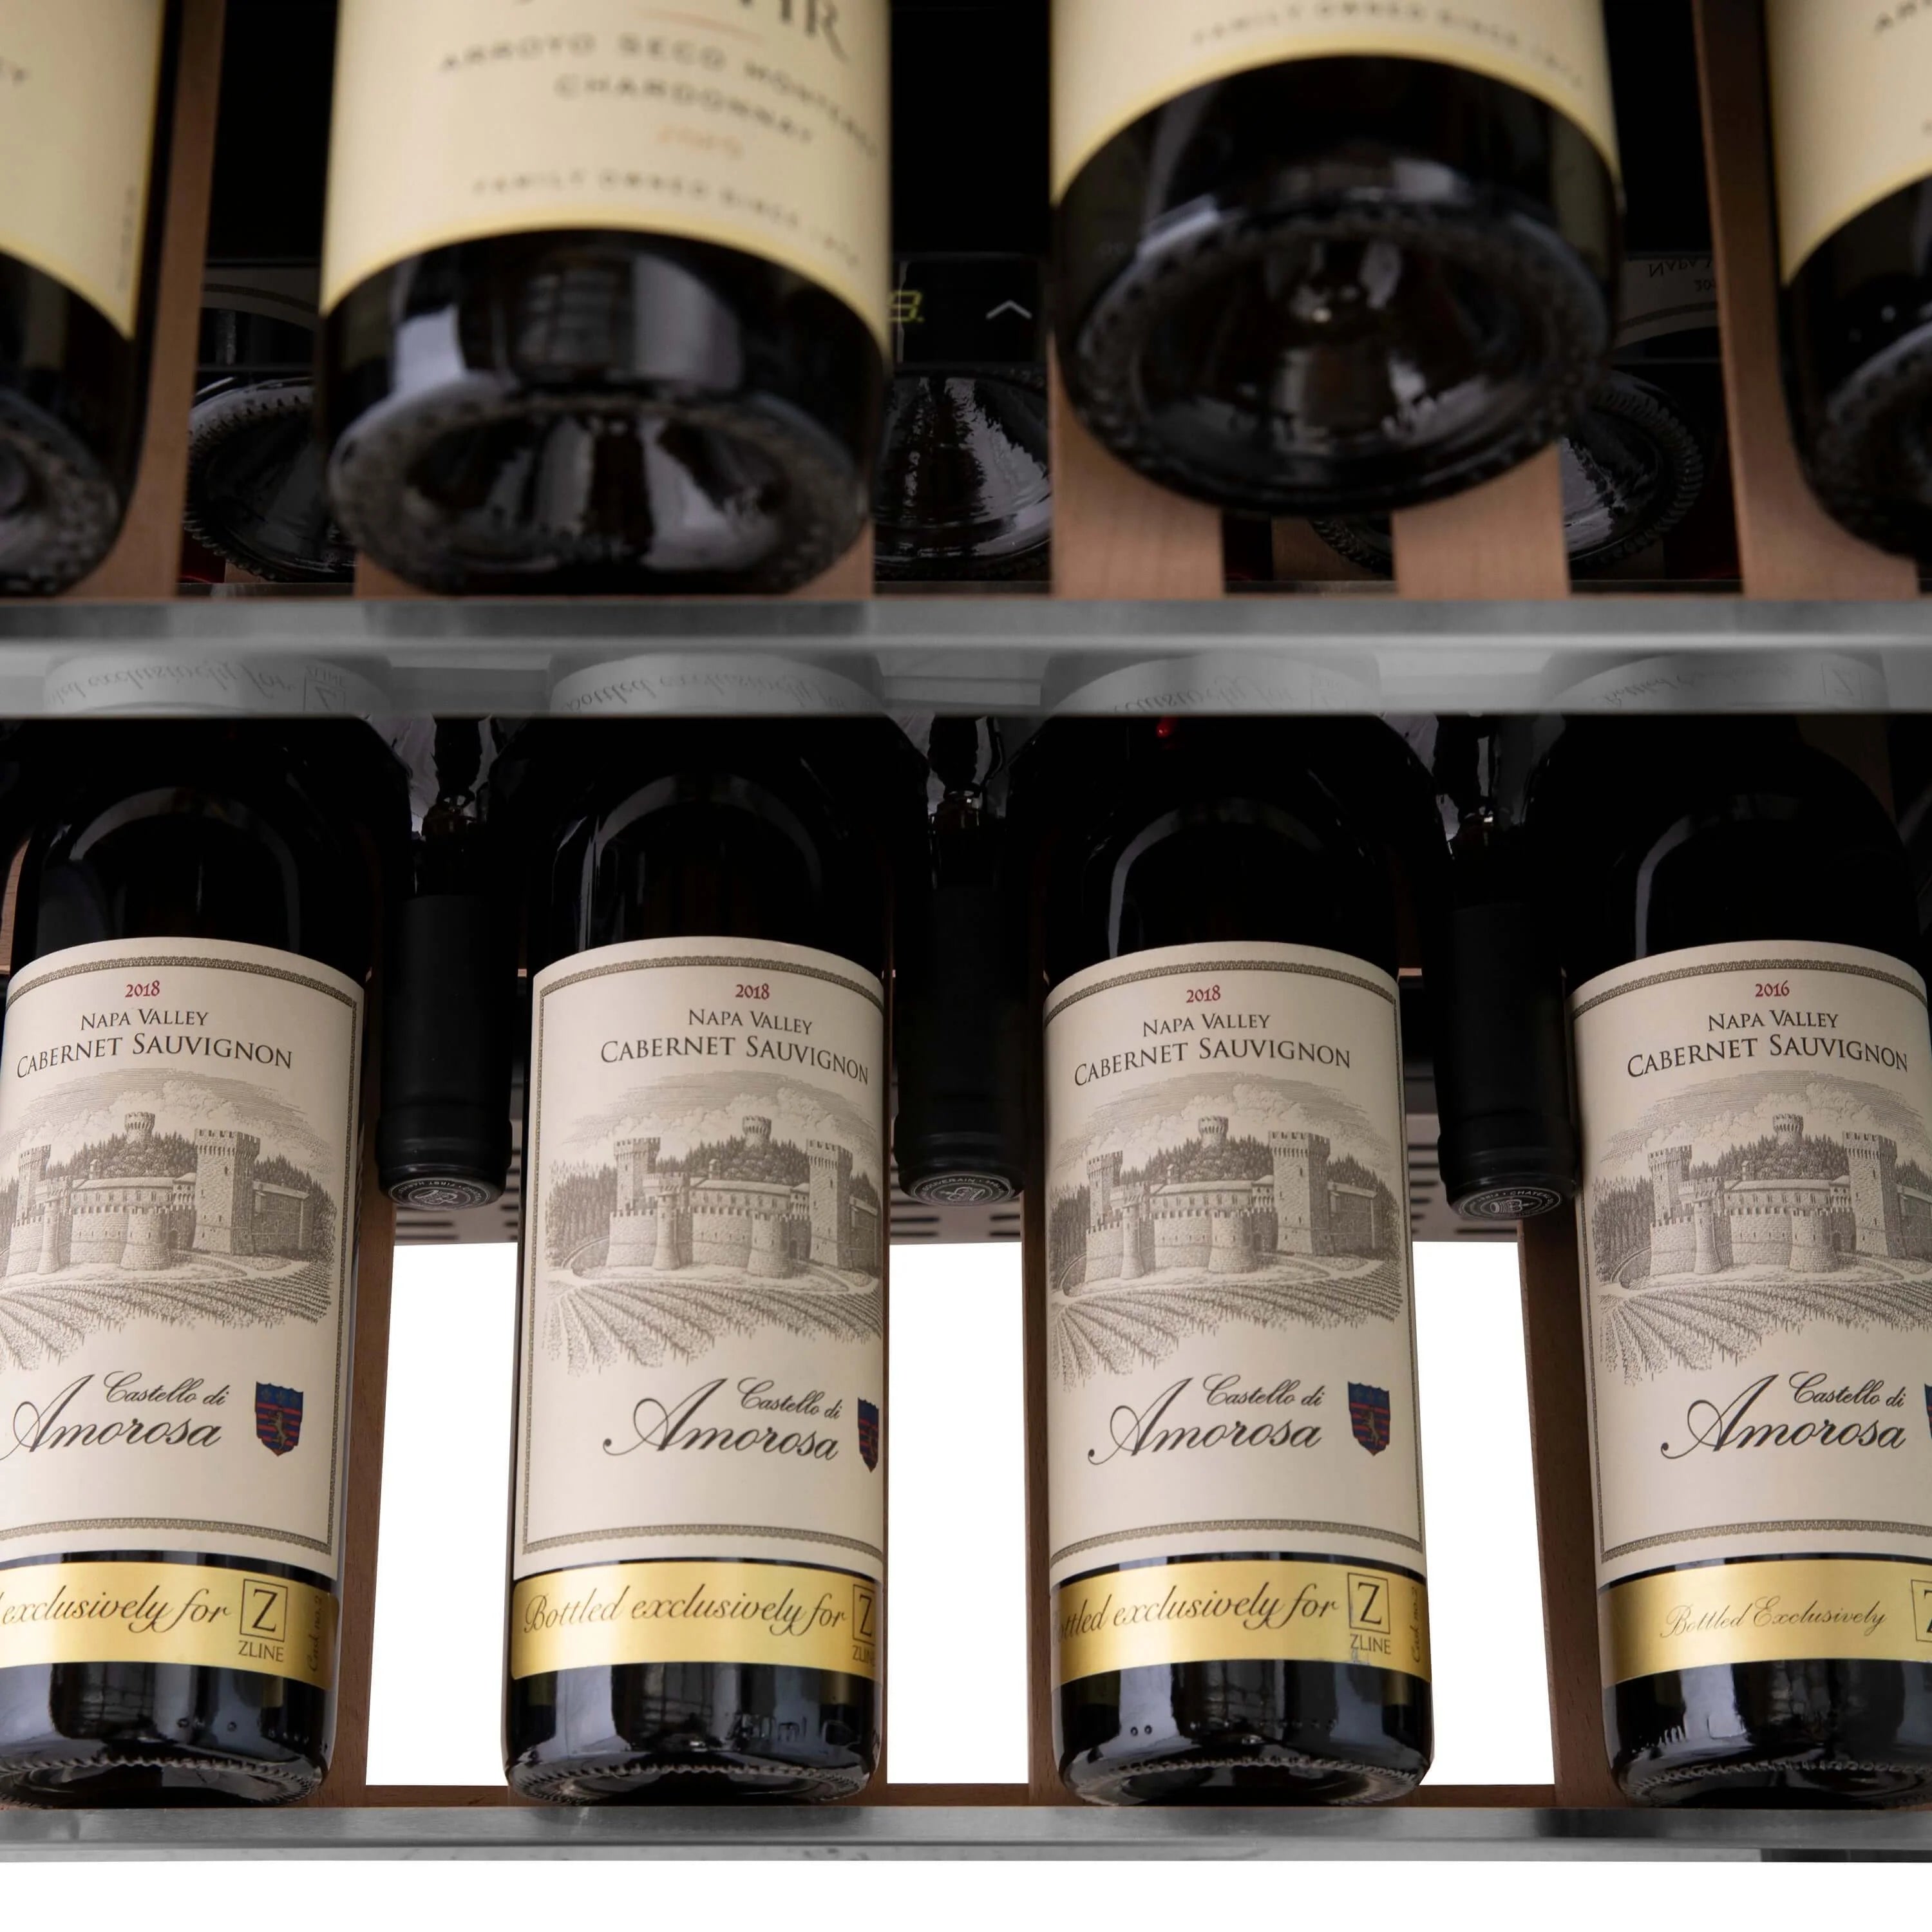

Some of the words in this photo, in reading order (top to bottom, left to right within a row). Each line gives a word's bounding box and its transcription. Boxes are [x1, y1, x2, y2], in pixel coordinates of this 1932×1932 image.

[125, 980, 160, 998] 2018
[735, 983, 770, 1000] 2018
[1186, 985, 1221, 1004] 2018
[1755, 980, 1790, 998] 2016
[80, 1012, 131, 1031] NAPA
[138, 1009, 209, 1027] VALLEY
[688, 1009, 743, 1027] NAPA
[749, 1010, 813, 1036] VALLEY
[1142, 1016, 1195, 1037] NAPA
[1201, 1013, 1272, 1030] VALLEY
[1708, 1012, 1765, 1032] NAPA
[1769, 1009, 1840, 1029] VALLEY
[17, 1037, 123, 1079] CABERNET
[133, 1033, 293, 1069] SAUVIGNON
[601, 1036, 735, 1063] CABERNET
[746, 1034, 869, 1085] SAUVIGNON
[1074, 1042, 1189, 1087] CABERNET
[1198, 1037, 1351, 1069] SAUVIGNON
[1627, 1037, 1758, 1078] CABERNET
[1770, 1034, 1908, 1073] SAUVIGNON
[104, 1370, 205, 1405] Castello
[203, 1384, 231, 1406] di
[737, 1376, 825, 1416] Castello
[824, 1399, 841, 1420] di
[1202, 1373, 1301, 1406] Castello
[1301, 1385, 1326, 1407] di
[1789, 1371, 1886, 1406] Castello
[1886, 1386, 1908, 1408] di
[0, 1374, 223, 1461] Amorosa
[603, 1378, 840, 1461] Amorosa
[1088, 1376, 1322, 1466] Amorosa
[1661, 1374, 1907, 1460] Amorosa
[1, 1584, 169, 1633] exclusively
[158, 1587, 232, 1633] for
[252, 1588, 278, 1633] Z
[524, 1584, 631, 1634] Bottled
[630, 1583, 804, 1636] exclusively
[795, 1592, 849, 1636] for
[858, 1594, 873, 1636] Z
[1113, 1581, 1285, 1631] exclusively
[1276, 1583, 1340, 1631] for
[1358, 1581, 1382, 1626] Z
[1659, 1604, 1754, 1639] Bottled
[1752, 1595, 1888, 1637] Exclusively
[238, 1640, 285, 1663] ZLINE
[1350, 1633, 1392, 1656] ZLINE
